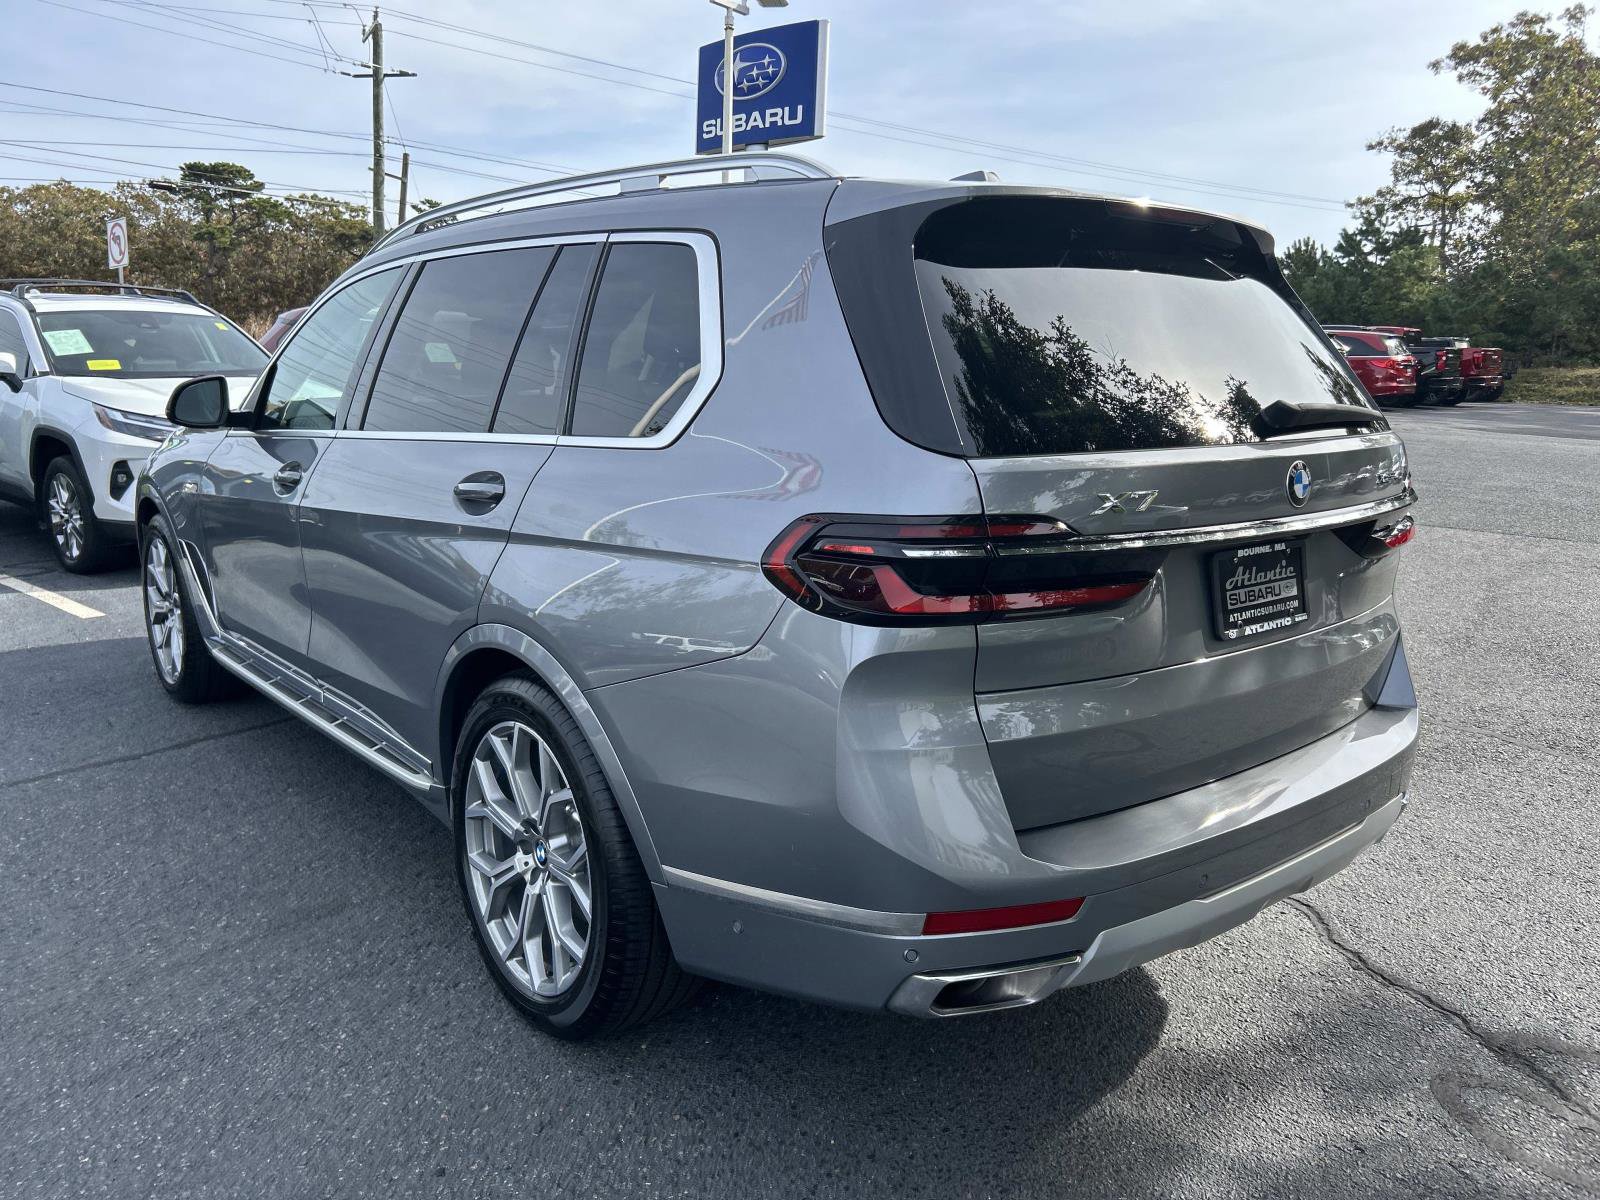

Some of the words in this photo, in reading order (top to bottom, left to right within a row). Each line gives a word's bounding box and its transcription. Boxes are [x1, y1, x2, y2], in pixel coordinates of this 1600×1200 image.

[1089, 489, 1159, 515] X7
[1274, 542, 1286, 551] MA
[1226, 560, 1297, 589] Atlantic
[1228, 585, 1281, 606] SUBARU
[1229, 600, 1298, 622] ATLANTICSUBARU.COM
[1244, 616, 1292, 636] ATLANTIC
